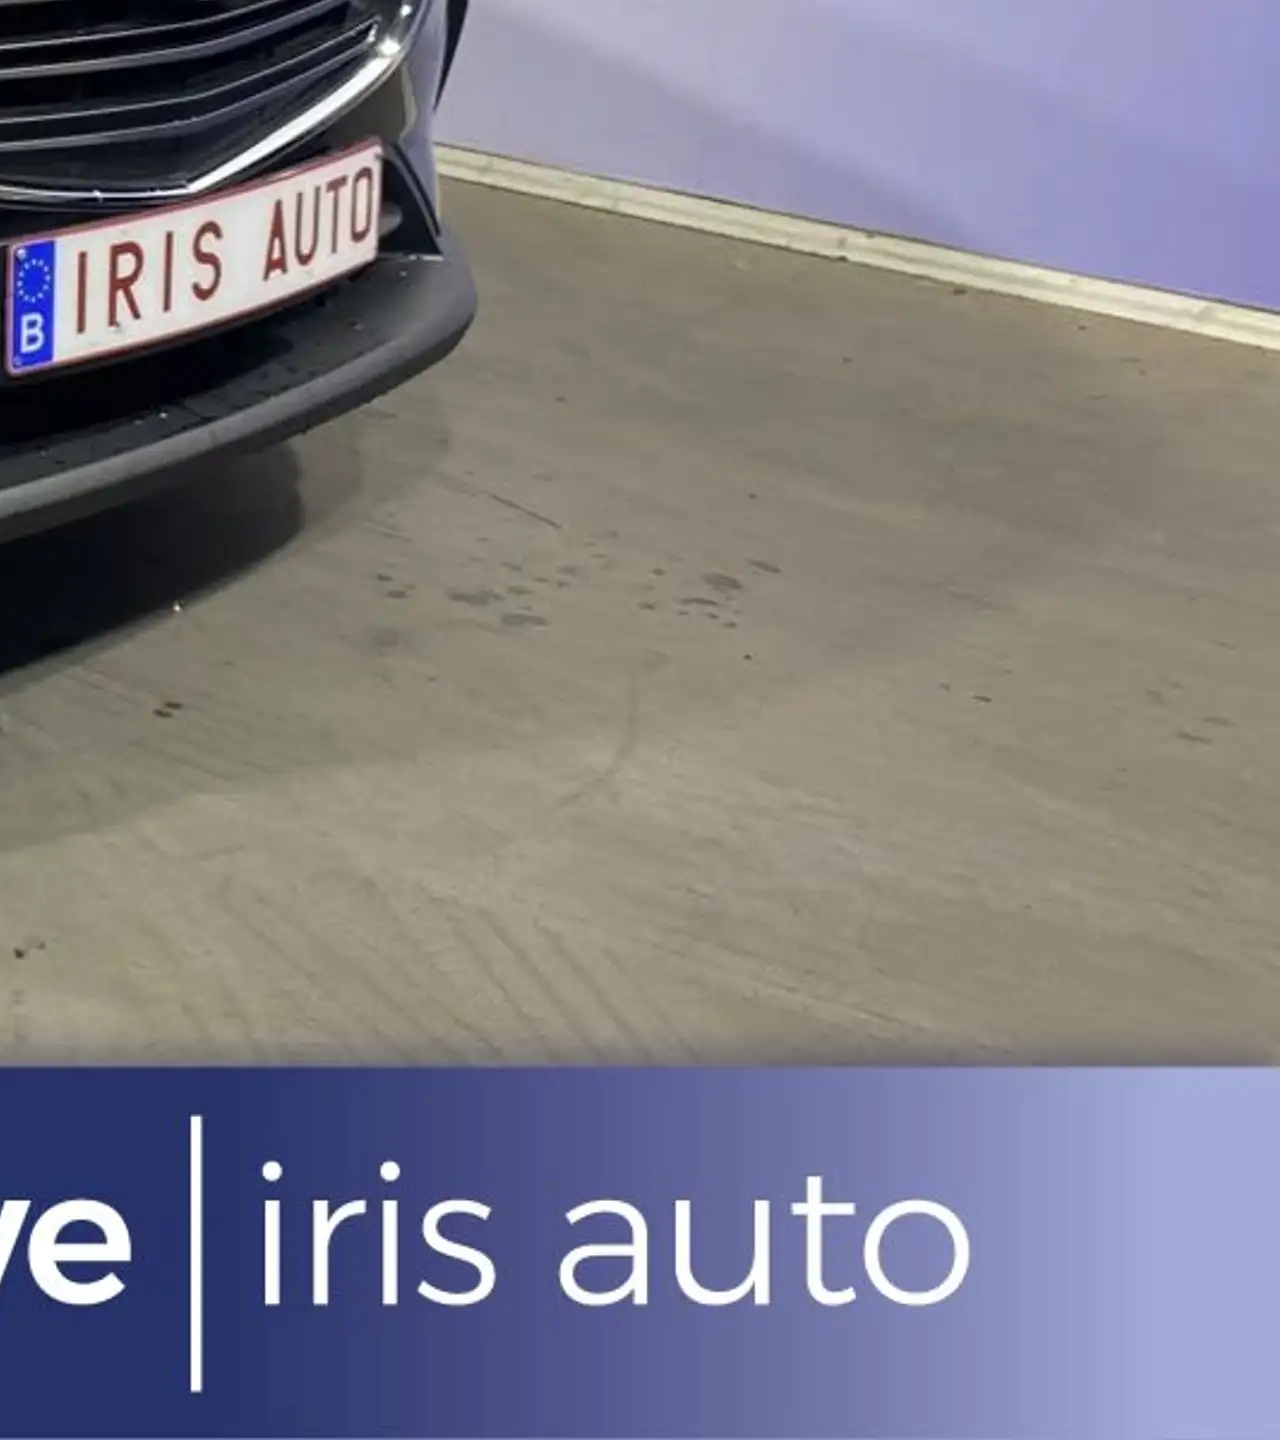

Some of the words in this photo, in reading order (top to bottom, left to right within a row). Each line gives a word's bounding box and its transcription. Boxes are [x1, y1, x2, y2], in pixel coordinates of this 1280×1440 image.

[75, 220, 223, 334] IRIS
[263, 166, 373, 282] AUTO
[20, 314, 46, 354] B
